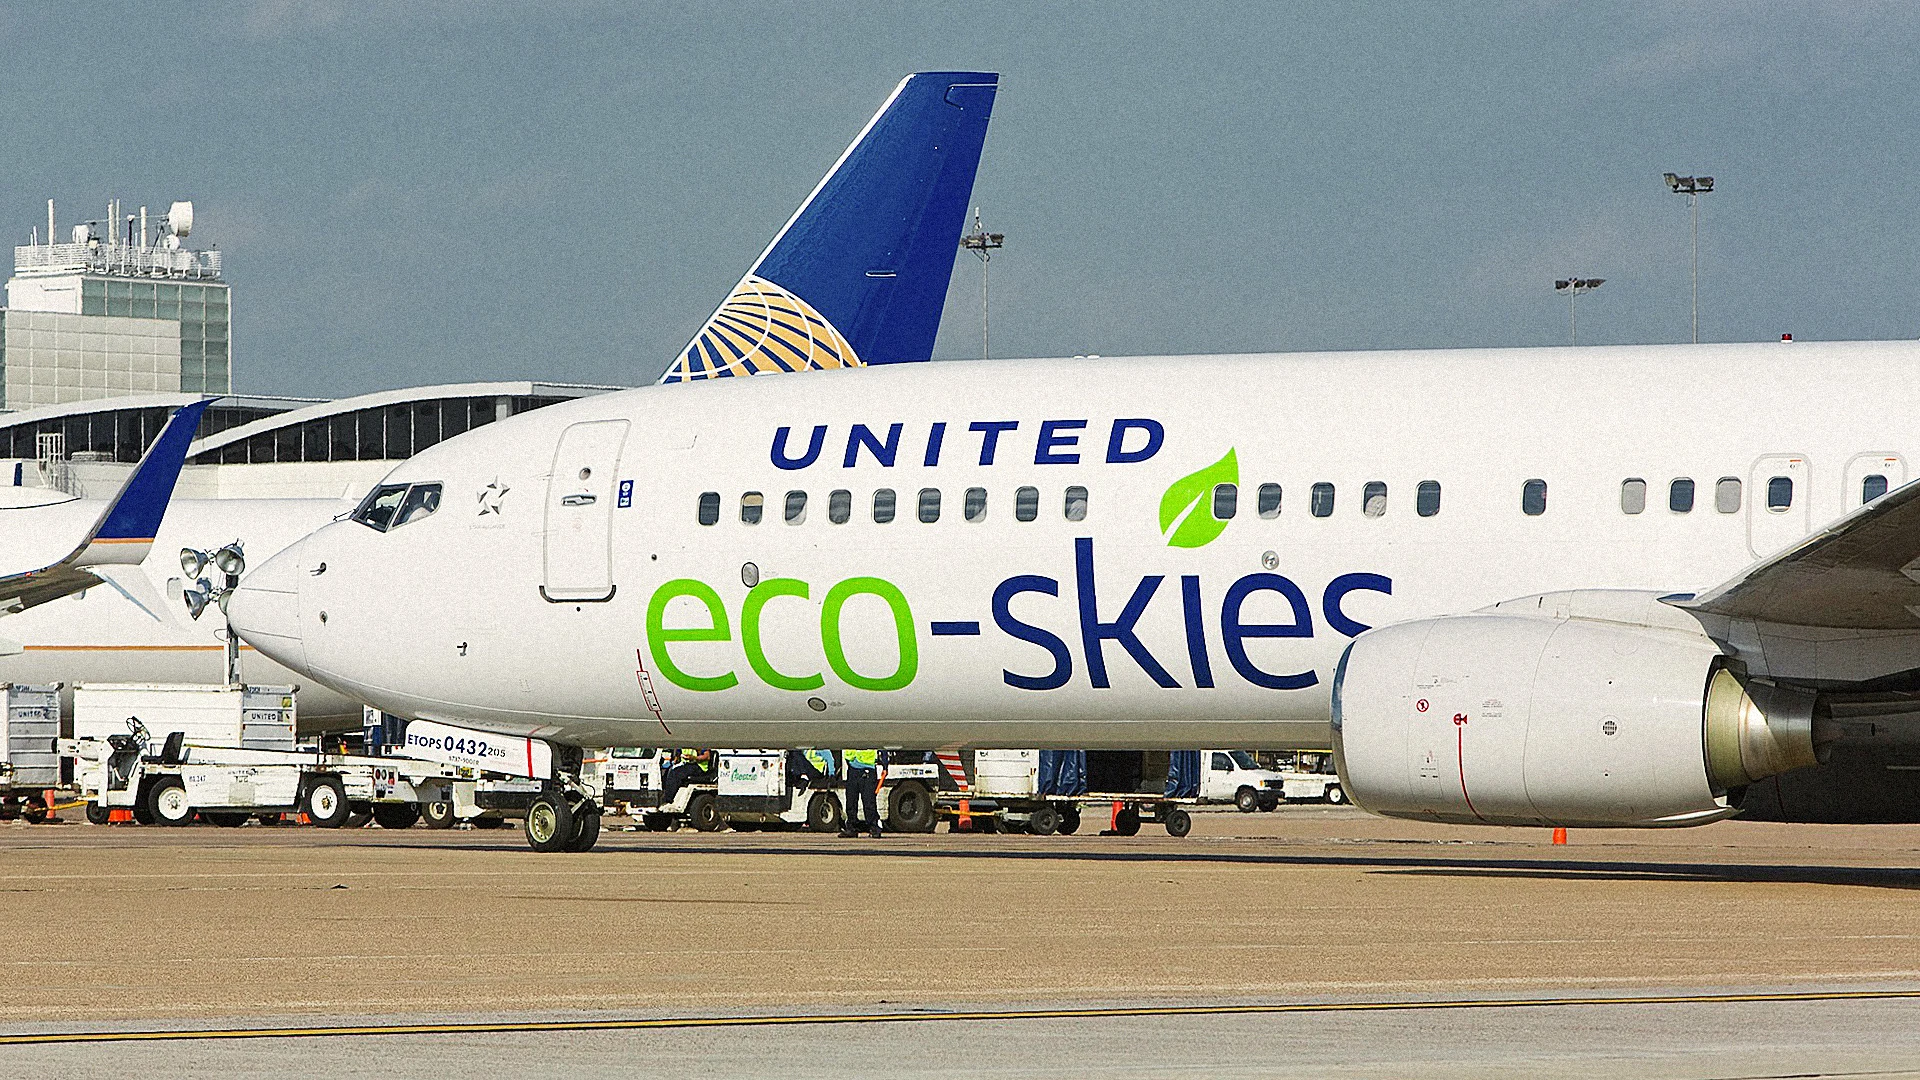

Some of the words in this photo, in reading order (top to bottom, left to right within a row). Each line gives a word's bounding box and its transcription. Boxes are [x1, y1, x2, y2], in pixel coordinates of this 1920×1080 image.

[771, 419, 1164, 469] UNITED
[407, 733, 442, 749] ETOPS
[444, 735, 488, 757] 0432
[487, 747, 506, 758] 205
